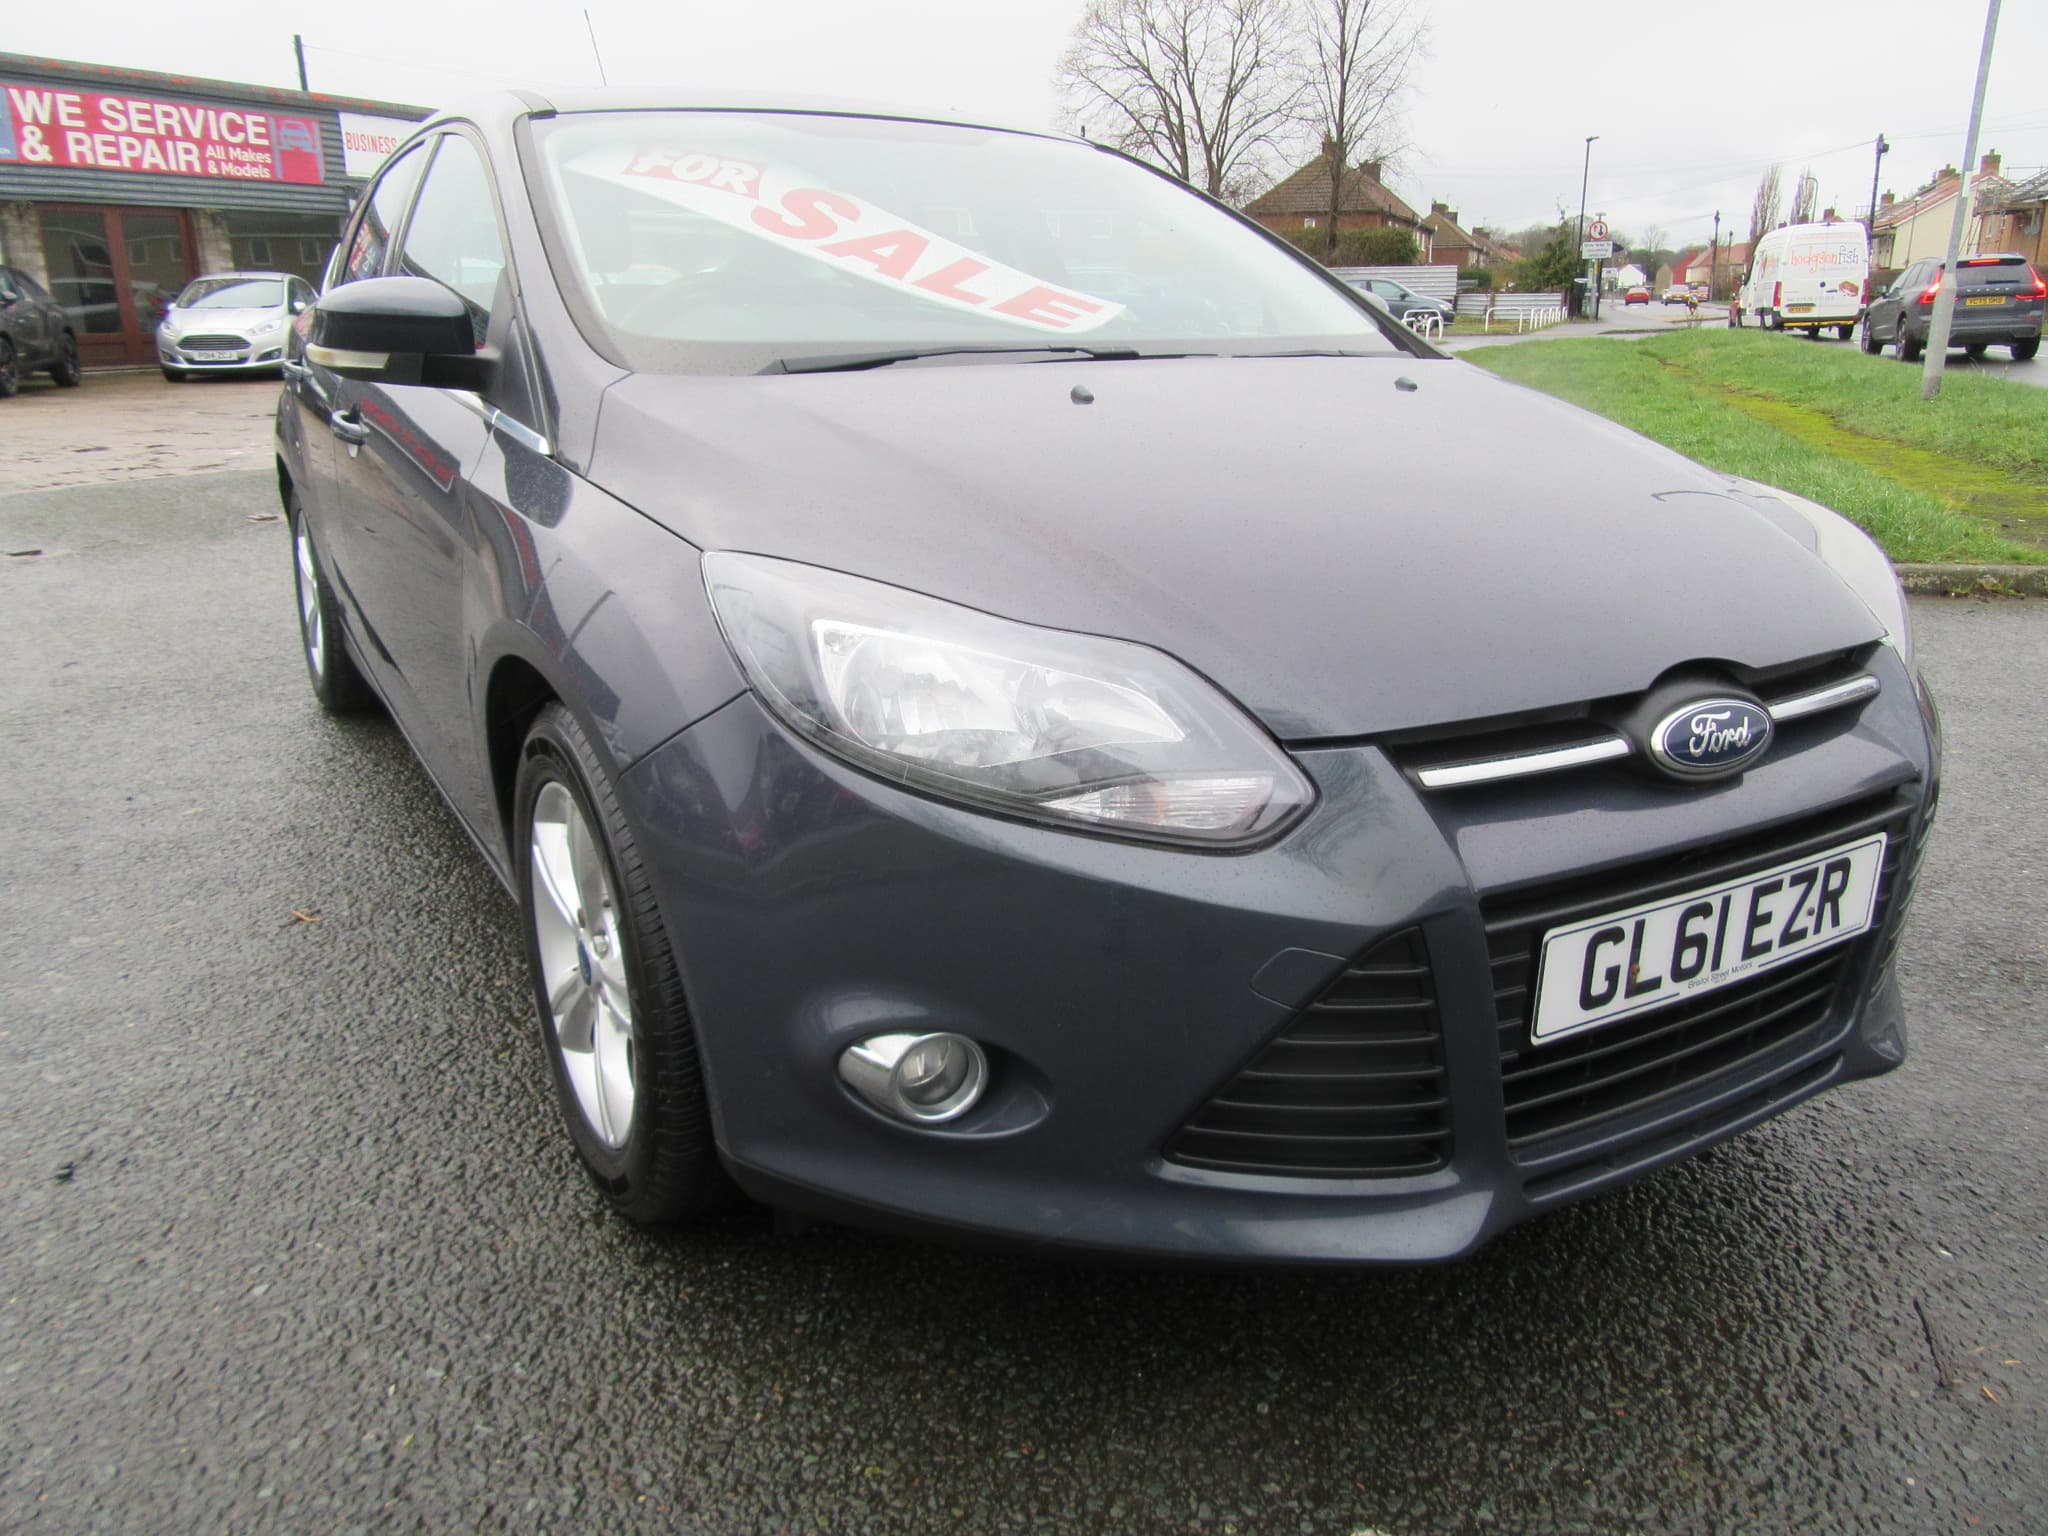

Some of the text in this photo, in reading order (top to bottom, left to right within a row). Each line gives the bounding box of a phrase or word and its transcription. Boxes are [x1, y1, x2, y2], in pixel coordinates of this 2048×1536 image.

[8, 88, 270, 146] WE SERVICE
[21, 124, 202, 173] & REPAIR
[205, 144, 272, 164] All Makes
[345, 131, 397, 154] BUSINESS
[207, 160, 271, 178] & Models
[630, 149, 1105, 328] FOR SALE
[1688, 710, 1751, 758] Ford
[1579, 856, 1852, 1011] GL61 EZR
